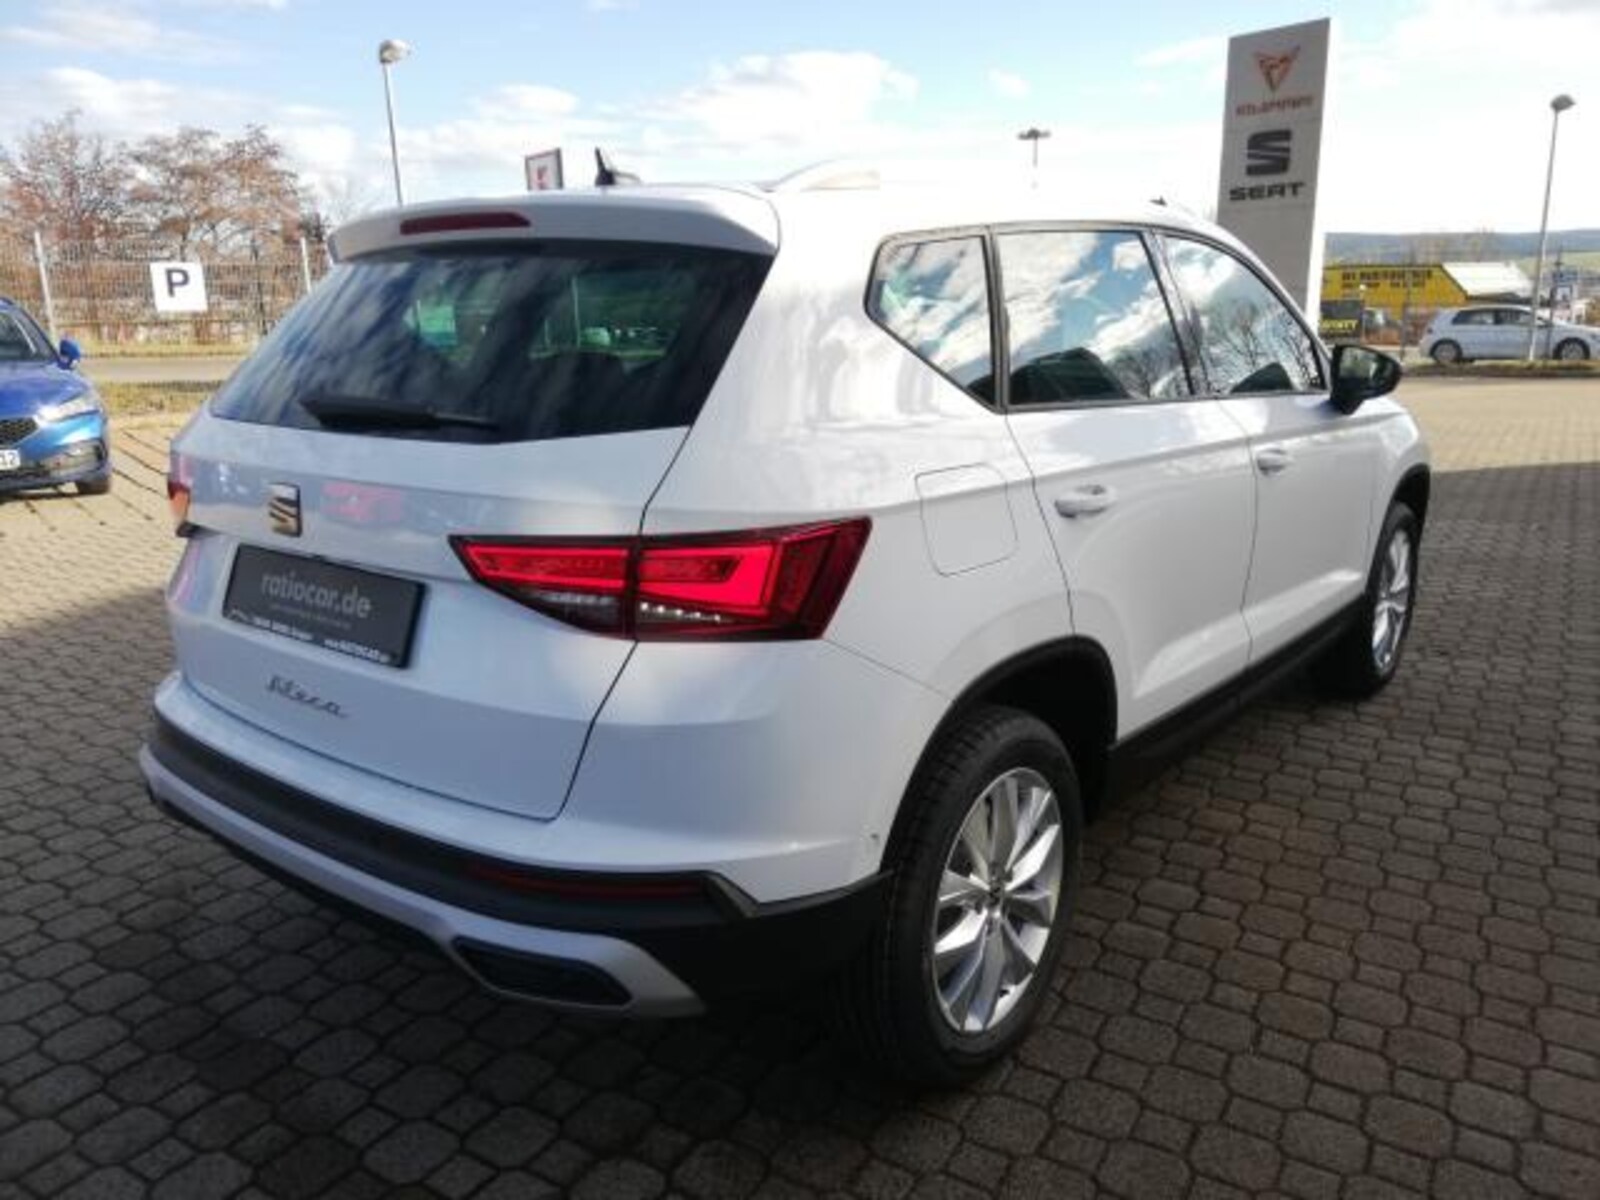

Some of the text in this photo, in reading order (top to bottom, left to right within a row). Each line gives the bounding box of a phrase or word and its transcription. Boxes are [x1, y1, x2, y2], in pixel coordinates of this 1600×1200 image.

[1229, 181, 1305, 201] SEAT
[165, 268, 190, 297] P
[261, 570, 371, 618] ratiocar.de
